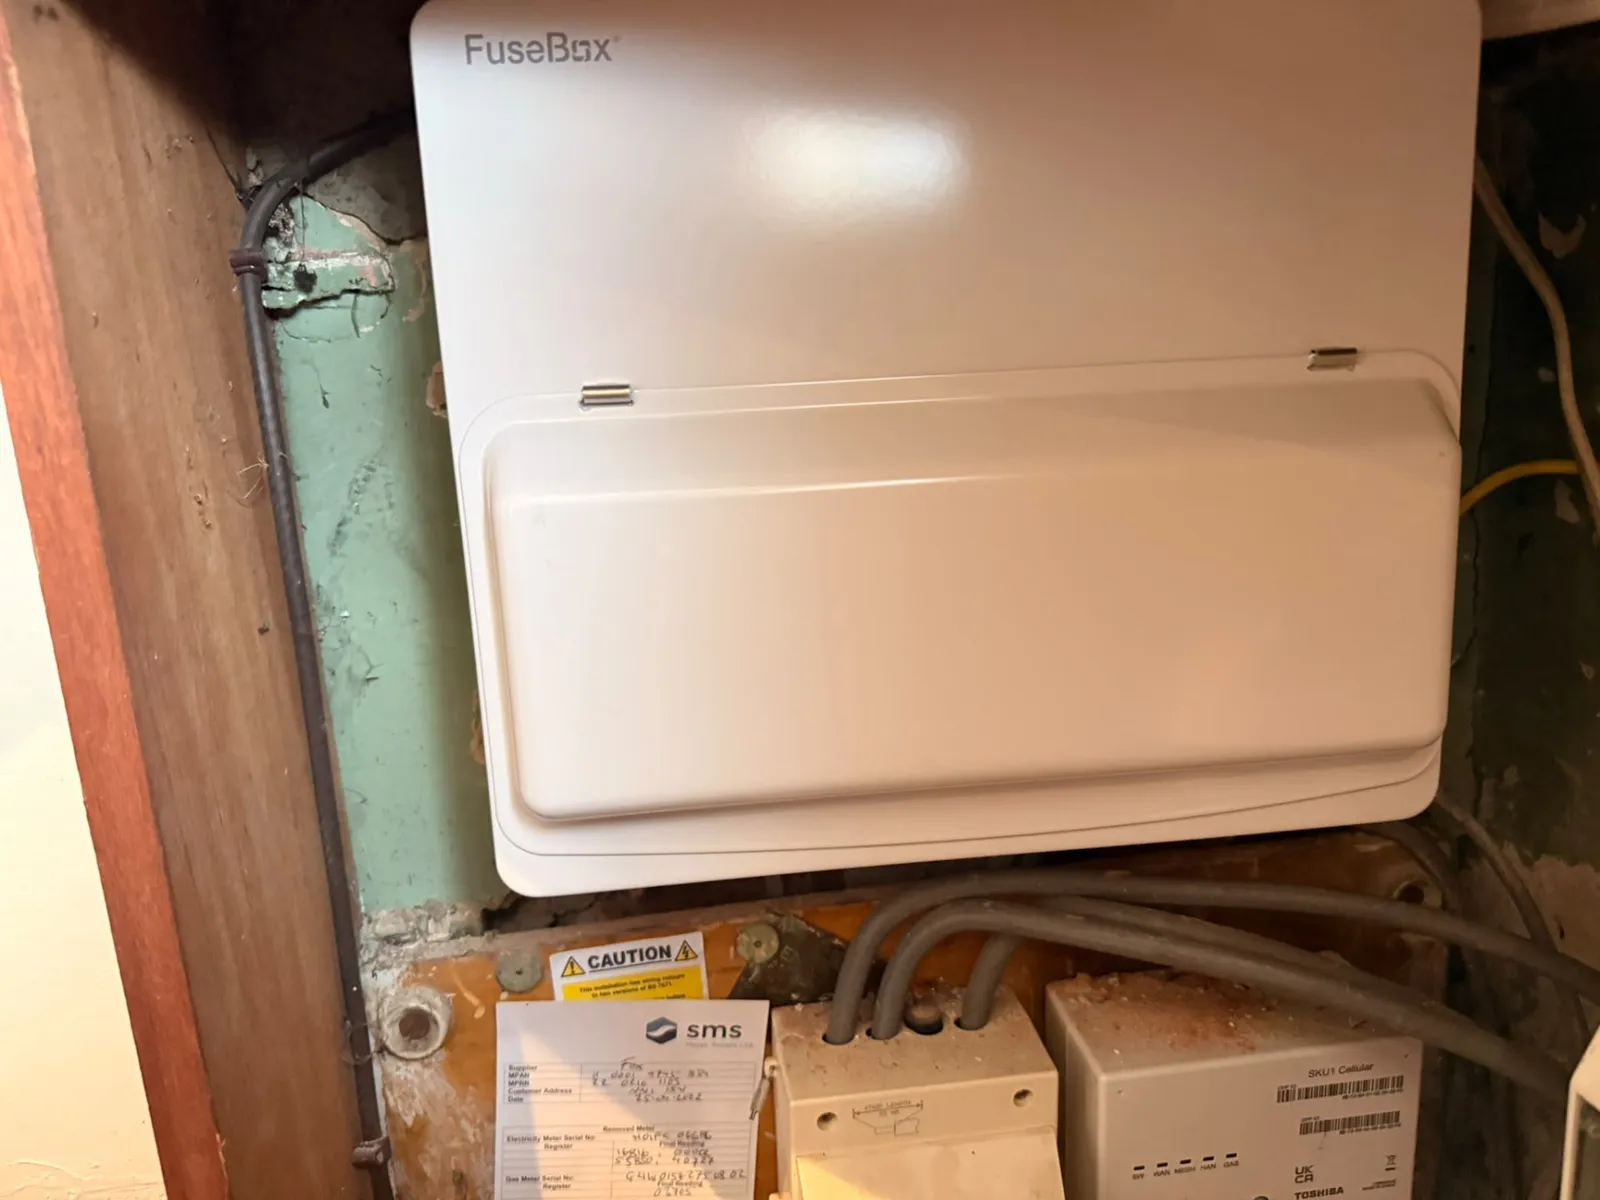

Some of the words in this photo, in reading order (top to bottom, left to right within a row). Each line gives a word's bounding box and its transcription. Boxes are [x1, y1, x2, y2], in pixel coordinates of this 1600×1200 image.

[464, 32, 612, 64] FuseBox
[587, 944, 672, 969] CAUTION
[686, 1023, 742, 1038] sms
[1307, 1067, 1335, 1079] SKU1
[1338, 1063, 1375, 1075] Cellular
[507, 1135, 541, 1143] Electricity
[544, 1143, 573, 1151] Register
[1153, 1169, 1171, 1177] WAN
[1295, 1165, 1314, 1175] UK
[1294, 1174, 1314, 1184] CA
[543, 1183, 571, 1191] Register
[1294, 1186, 1345, 1200] TOSHIBA
